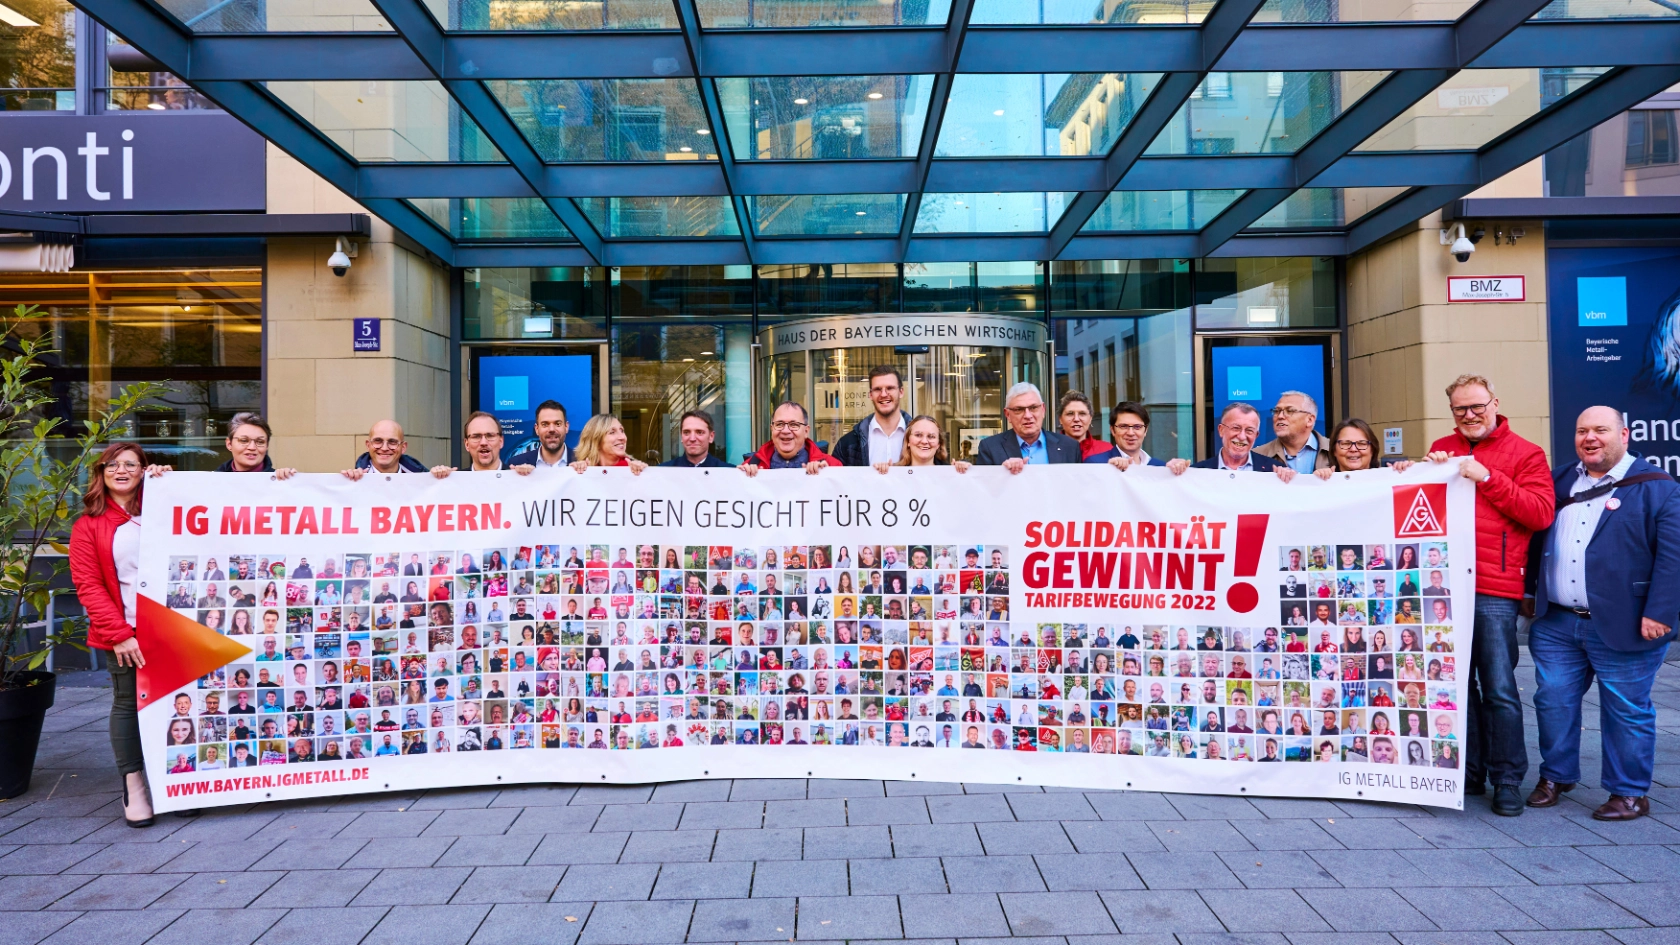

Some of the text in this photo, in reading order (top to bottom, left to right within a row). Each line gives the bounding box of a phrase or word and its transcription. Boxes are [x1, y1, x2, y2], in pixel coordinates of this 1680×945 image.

[0, 129, 135, 201] nti
[1470, 280, 1502, 292] BMZ
[1585, 311, 1607, 319] vbm
[361, 320, 371, 336] 5
[778, 324, 1036, 346] HAUS DER BAYERISCHEN WIRTSCHAFT
[172, 494, 931, 535] IG METALL BAYERN. WIR ZEIGEN GESICHT FÜR 8 %
[1024, 515, 1227, 549] SOLIDARITÄT
[1022, 551, 1225, 592] GEWINNT
[1024, 592, 1216, 611] TARIFBEWEGUNG 2022
[166, 767, 370, 798] WWW.BAYERN.IGMETALL.DE
[1338, 771, 1351, 785] IG
[1355, 772, 1406, 789] METALL
